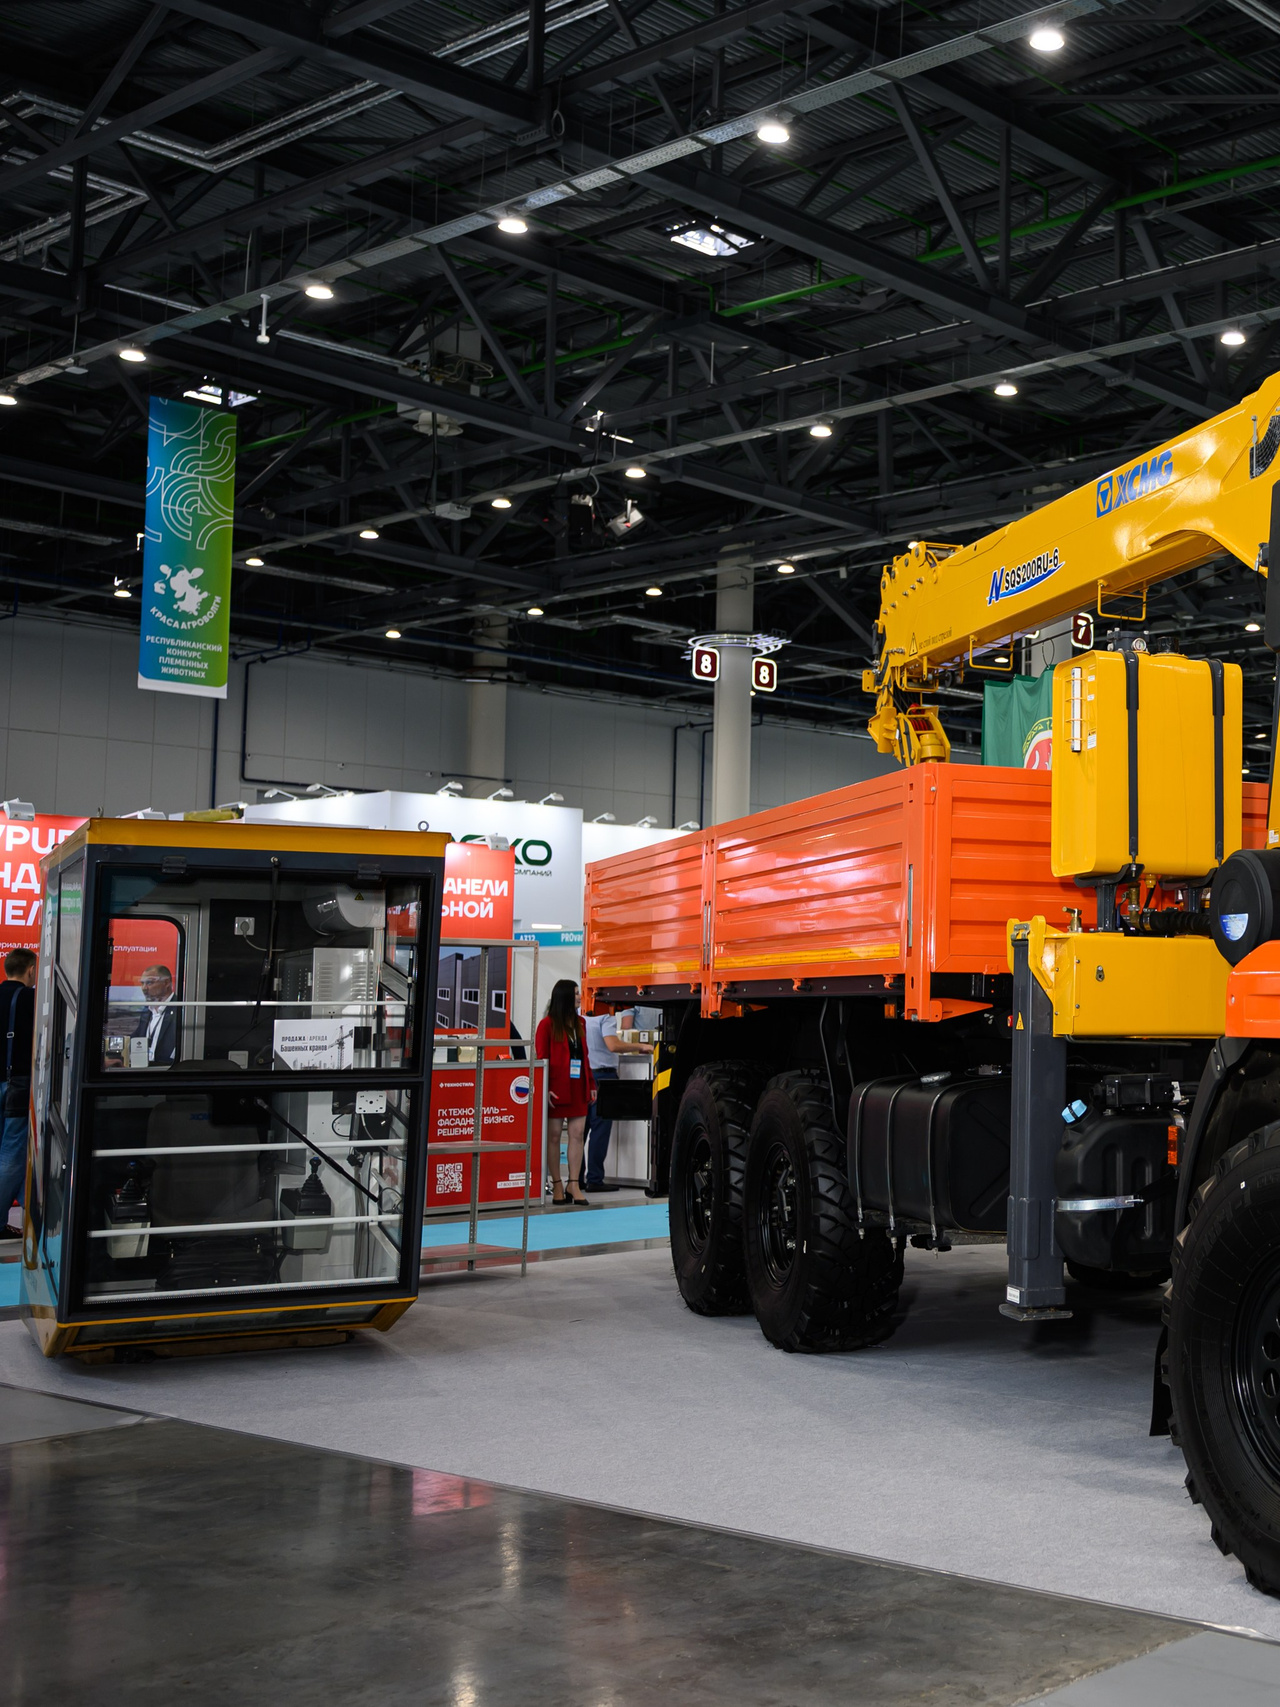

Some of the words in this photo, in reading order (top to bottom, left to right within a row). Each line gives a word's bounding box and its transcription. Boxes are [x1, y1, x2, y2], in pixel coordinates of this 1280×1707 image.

[1112, 450, 1173, 510] XCMG
[1004, 547, 1059, 591] SQS200RU-6
[150, 606, 179, 629] КРАСА
[181, 595, 222, 629] АГРОВОЛГИ
[1077, 619, 1087, 640] 7
[146, 635, 222, 652] РЕСПУБЛИКАНСКИЙ
[166, 648, 202, 659] КОНКУРС
[159, 656, 209, 669] ПЛЕМЕННЫХ
[700, 654, 712, 674] 8
[161, 666, 206, 678] ЖИВОТНЫХ
[759, 665, 770, 684] 8
[280, 1044, 308, 1052] Башенных
[309, 1044, 327, 1052] кранов
[448, 1106, 499, 1116] ТЕХНОТИЛЬ
[484, 1115, 514, 1124] БИЗНЕС
